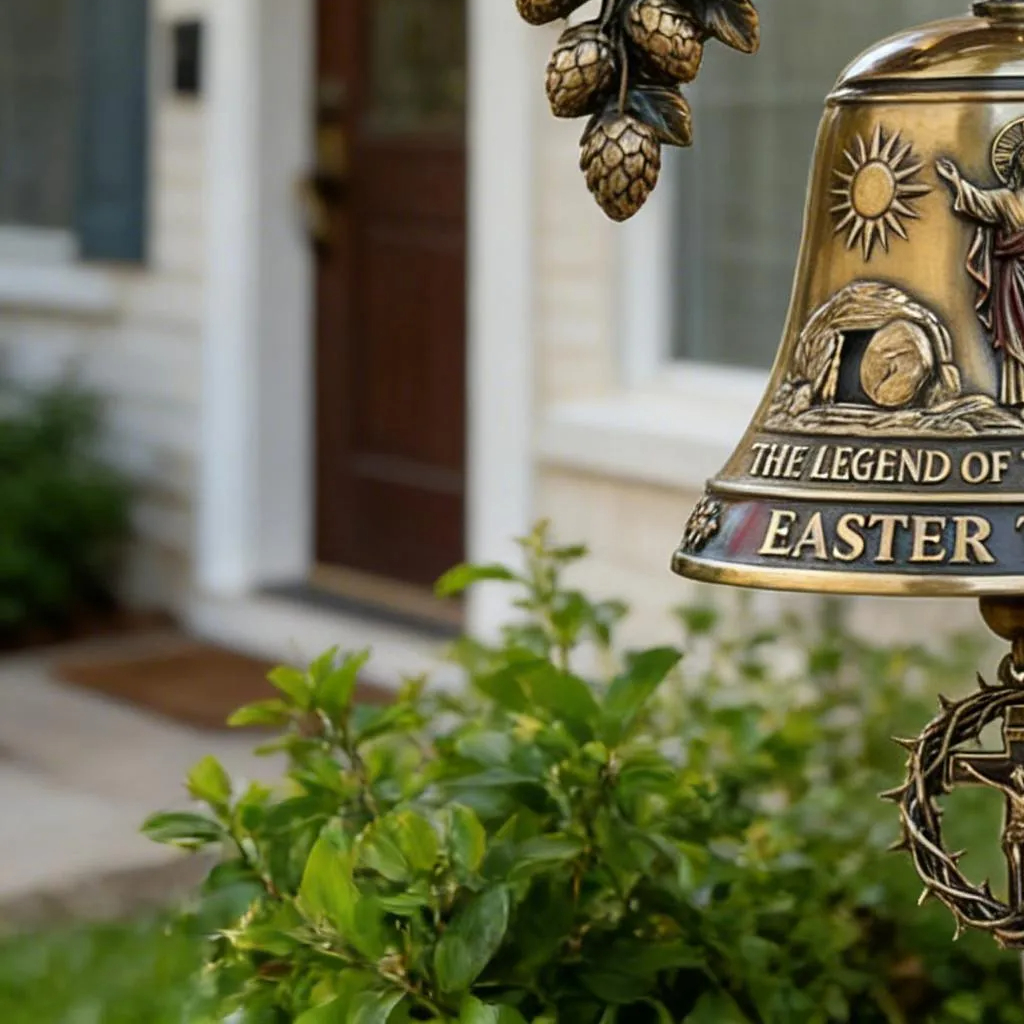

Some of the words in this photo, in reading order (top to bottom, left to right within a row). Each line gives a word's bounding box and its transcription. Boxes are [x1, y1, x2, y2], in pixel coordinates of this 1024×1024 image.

[749, 442, 806, 479] THE
[808, 445, 950, 484] LEGEND
[960, 449, 1013, 484] OF
[757, 508, 996, 564] EASTER
